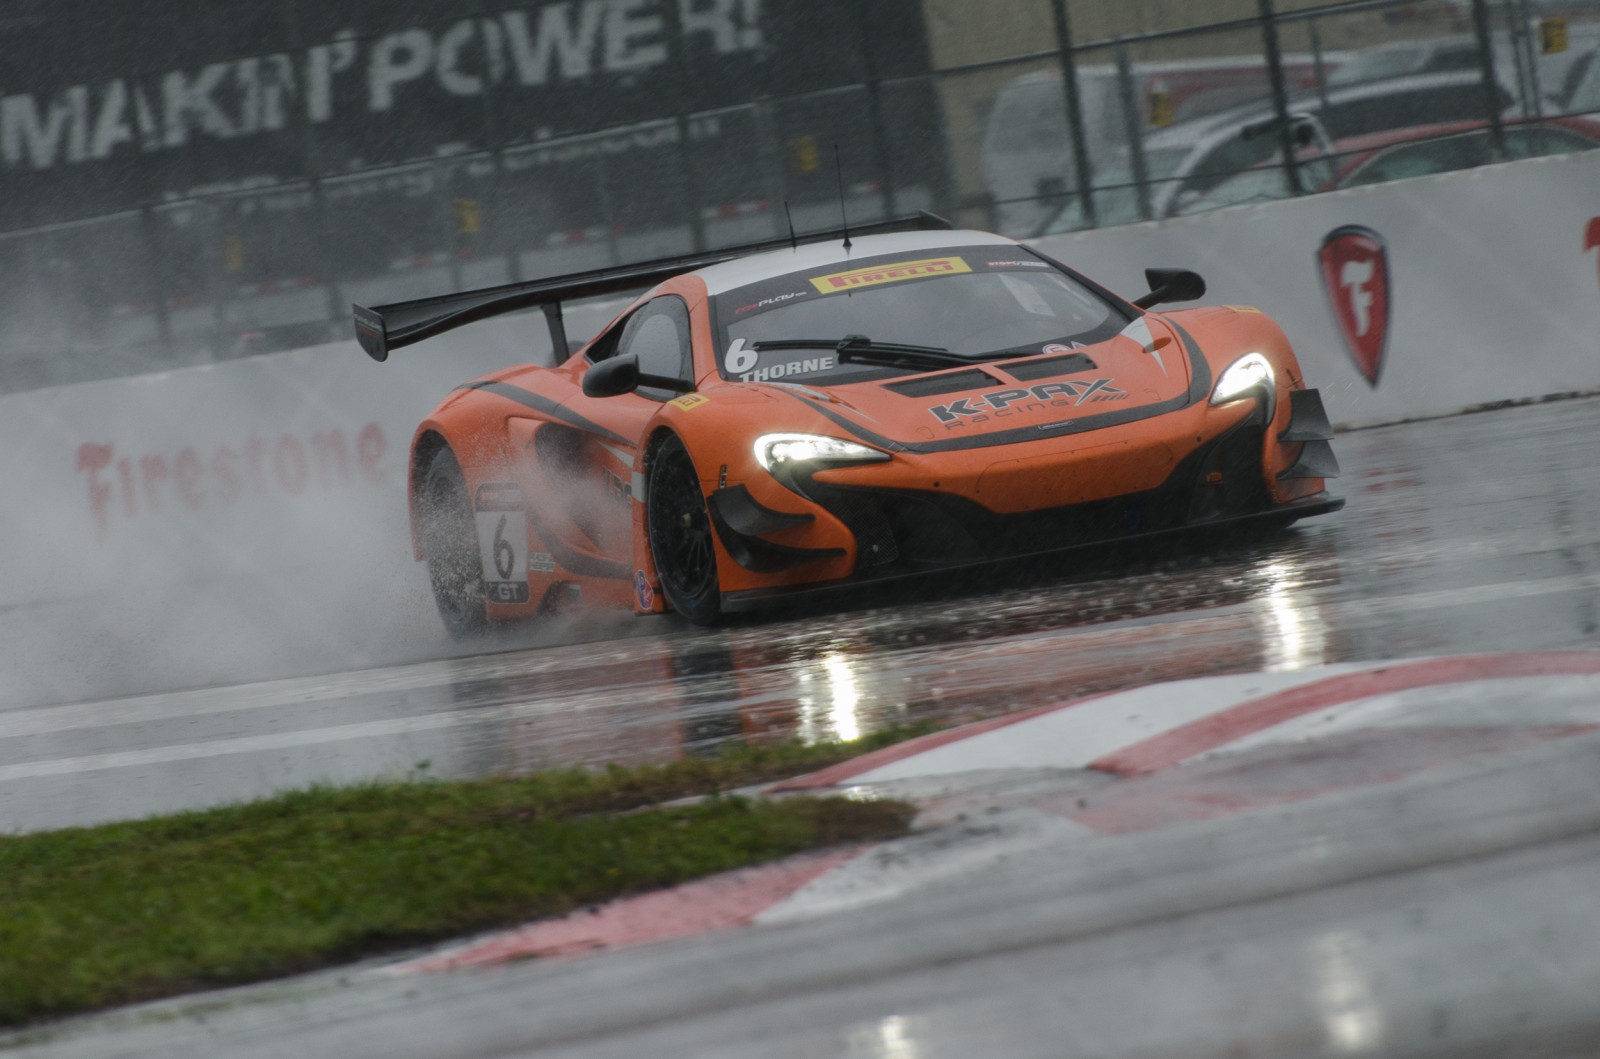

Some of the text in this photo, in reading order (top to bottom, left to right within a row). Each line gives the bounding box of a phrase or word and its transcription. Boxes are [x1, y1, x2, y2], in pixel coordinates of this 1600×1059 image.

[827, 260, 954, 289] PIRELLI
[724, 337, 759, 374] 6
[739, 356, 834, 383] THORNE
[927, 377, 1127, 424] K-PAX
[76, 421, 389, 541] Firestone
[492, 513, 515, 580] 6
[497, 583, 519, 600] GT
